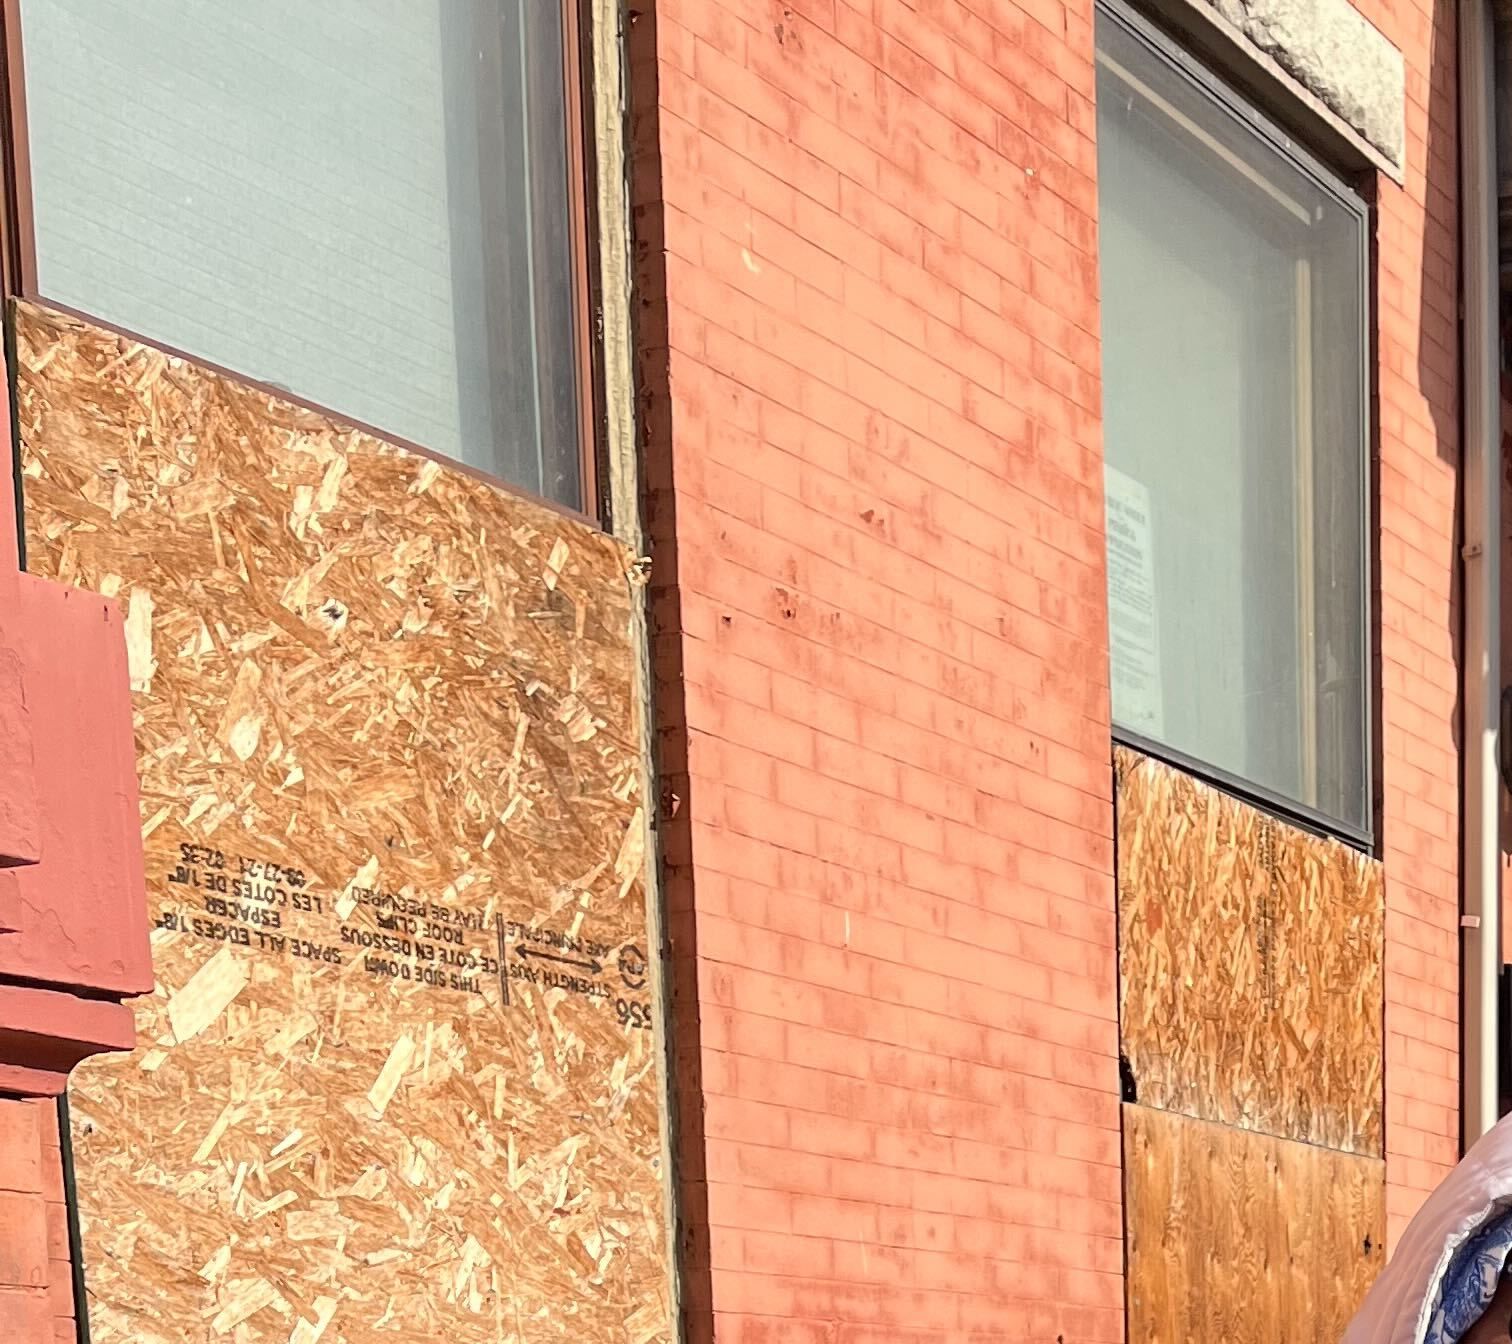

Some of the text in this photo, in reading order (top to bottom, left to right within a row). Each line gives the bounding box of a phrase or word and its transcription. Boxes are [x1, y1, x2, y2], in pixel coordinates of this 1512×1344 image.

[205, 872, 226, 893] DE
[232, 879, 287, 905] COTES
[203, 896, 281, 928] ESPACER
[292, 892, 322, 914] LES
[431, 904, 449, 924] BE
[193, 919, 250, 946] EDGES
[254, 931, 285, 951] ALL
[340, 926, 410, 956] DESSOUS
[422, 923, 464, 946] ROOF
[291, 938, 341, 964] SPACE
[415, 966, 445, 986] SIDE
[450, 976, 482, 994] THIS
